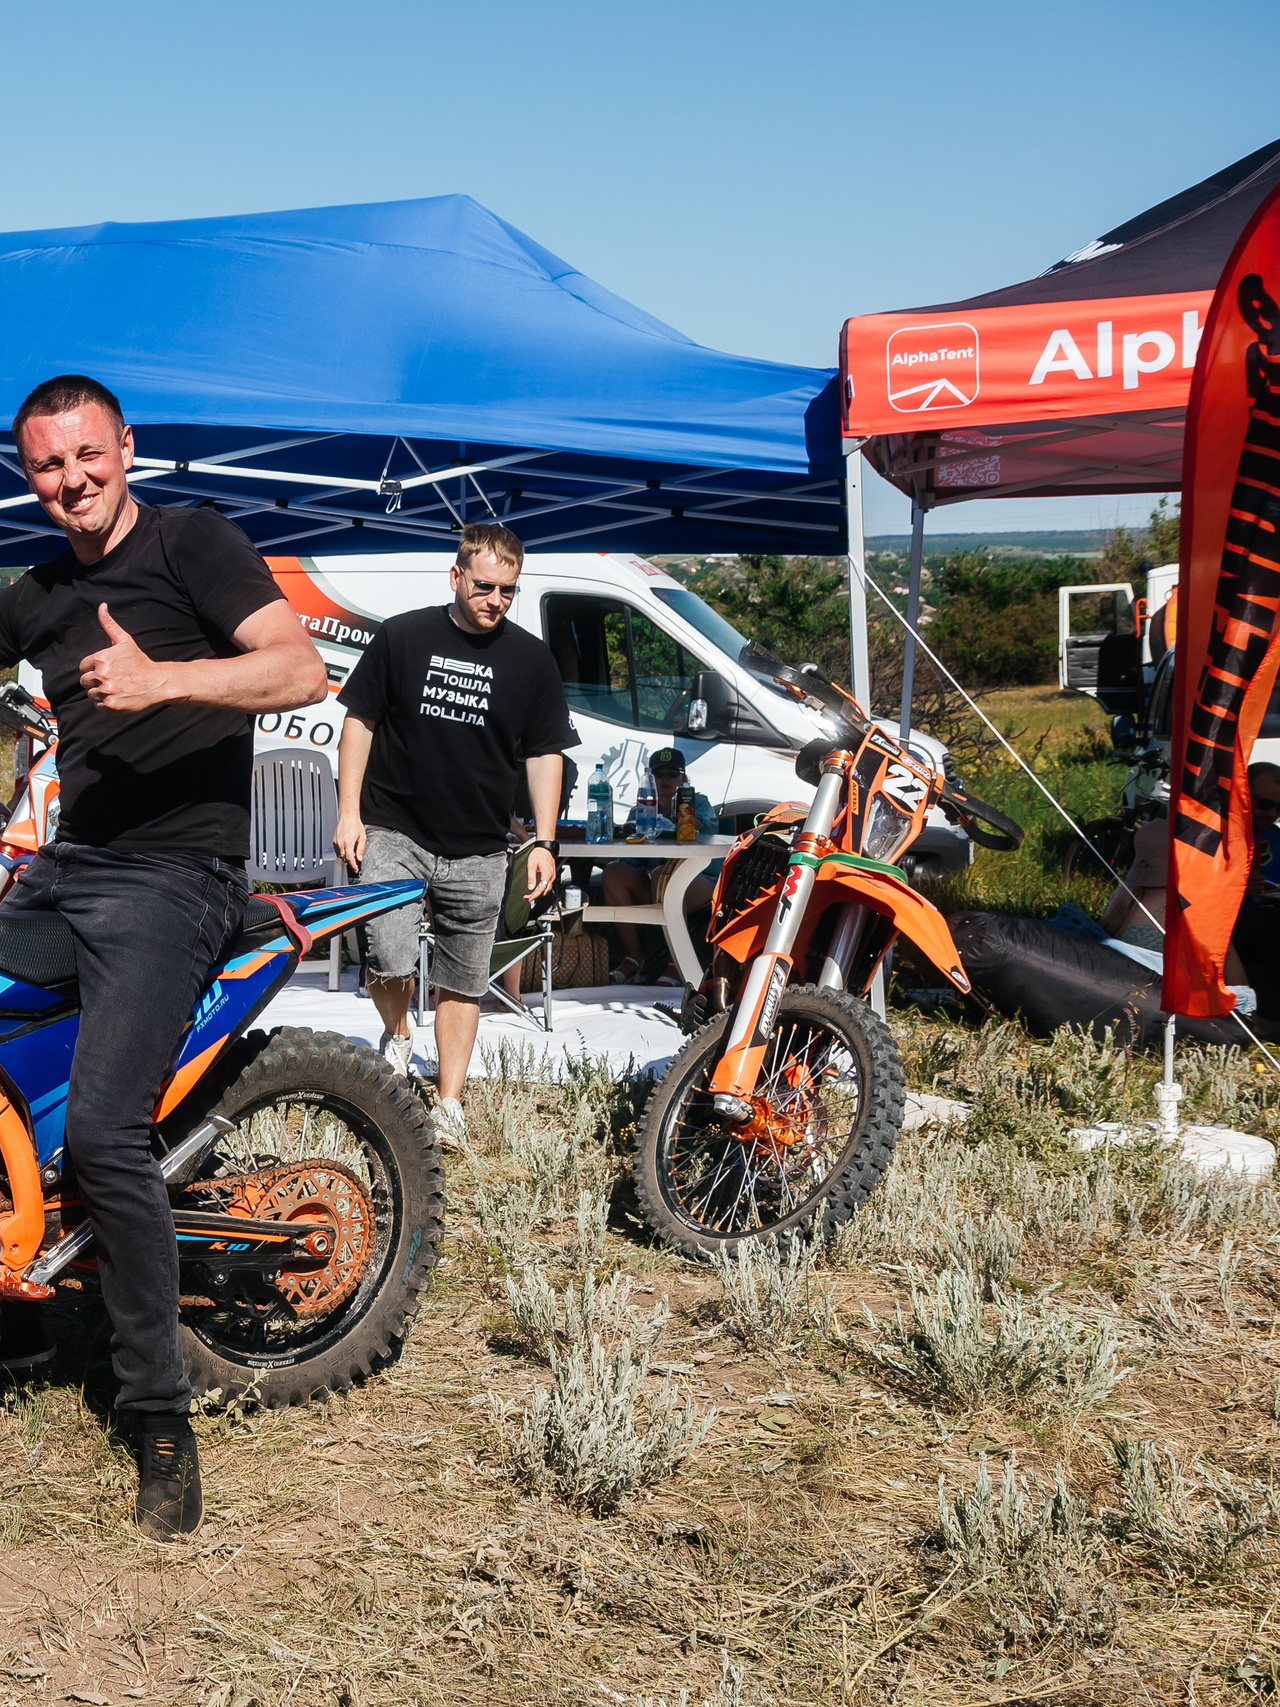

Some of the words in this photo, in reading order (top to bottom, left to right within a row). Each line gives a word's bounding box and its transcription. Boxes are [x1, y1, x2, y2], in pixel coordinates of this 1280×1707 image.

[891, 346, 974, 367] AlphaTent
[295, 612, 375, 645] таПром
[426, 670, 492, 694] ПОШЛА
[422, 685, 489, 711] МУЗЫКА
[420, 703, 485, 727] ПОШЛА
[196, 993, 230, 1033] FXMOTO.RU
[208, 1241, 250, 1251] K10
